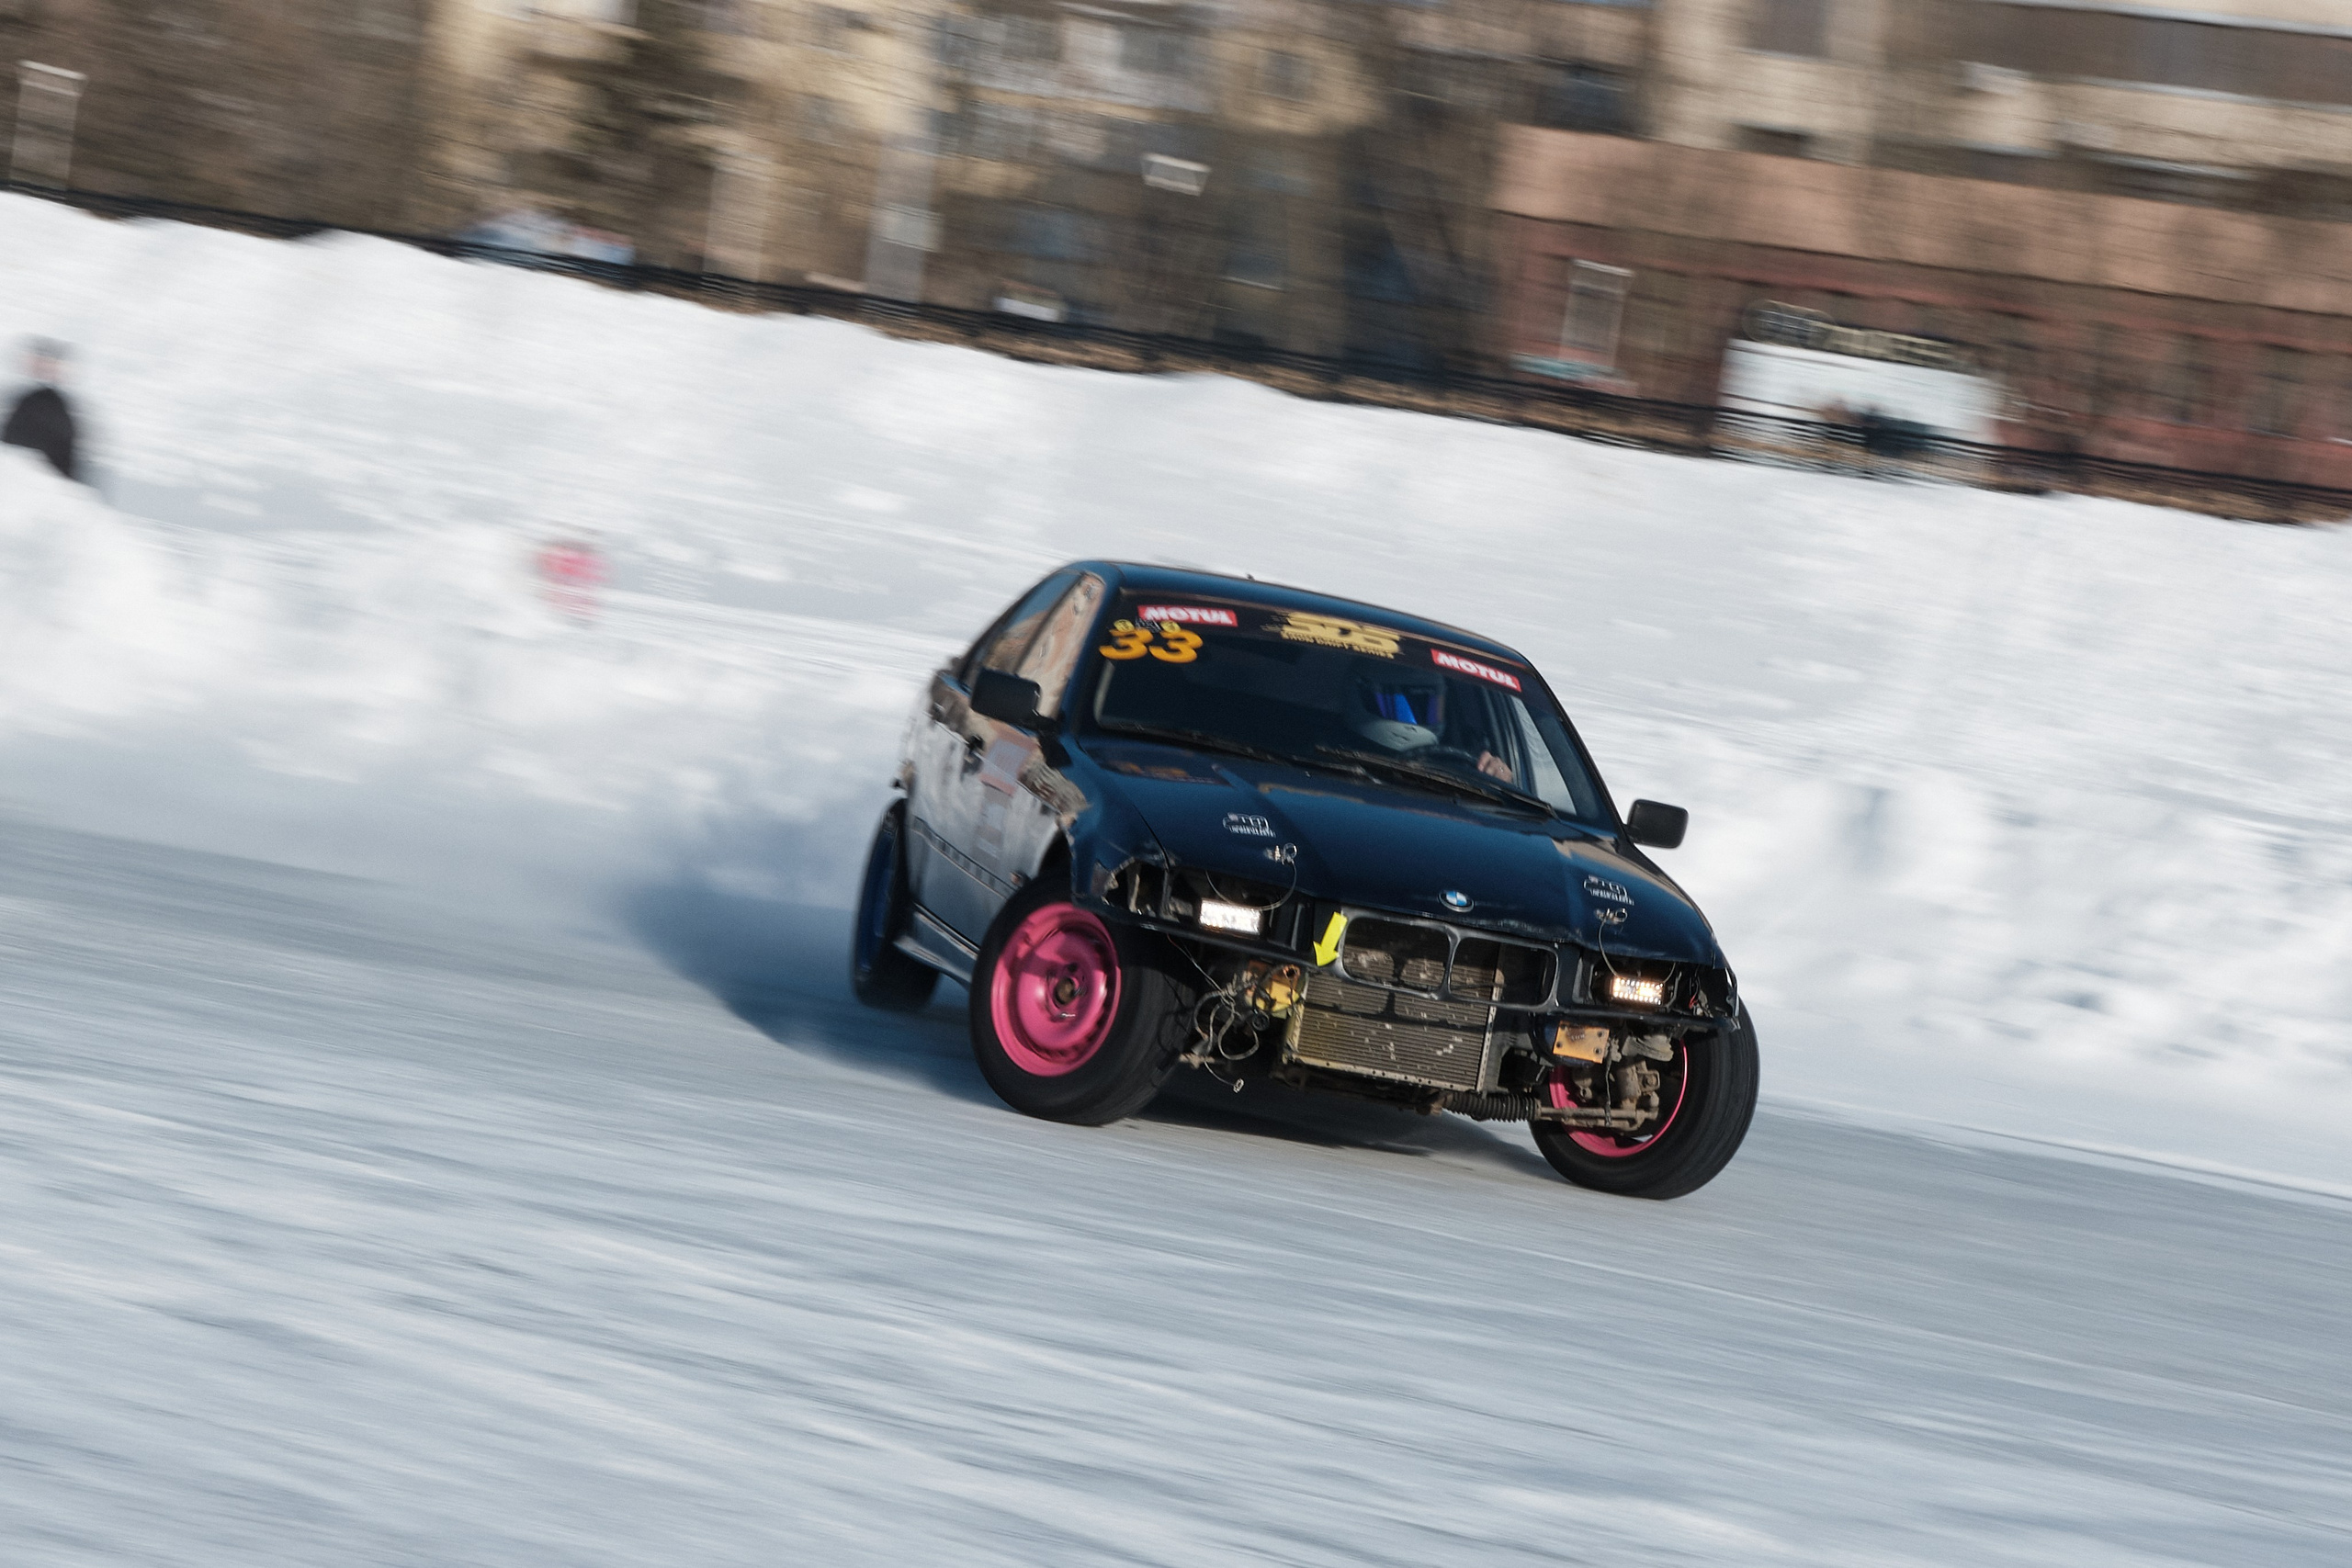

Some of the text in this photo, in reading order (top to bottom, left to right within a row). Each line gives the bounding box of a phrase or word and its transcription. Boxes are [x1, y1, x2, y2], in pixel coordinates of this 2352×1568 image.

[1144, 606, 1233, 625] MOTUL
[1099, 627, 1204, 663] 33
[1437, 652, 1518, 689] MOTUL
